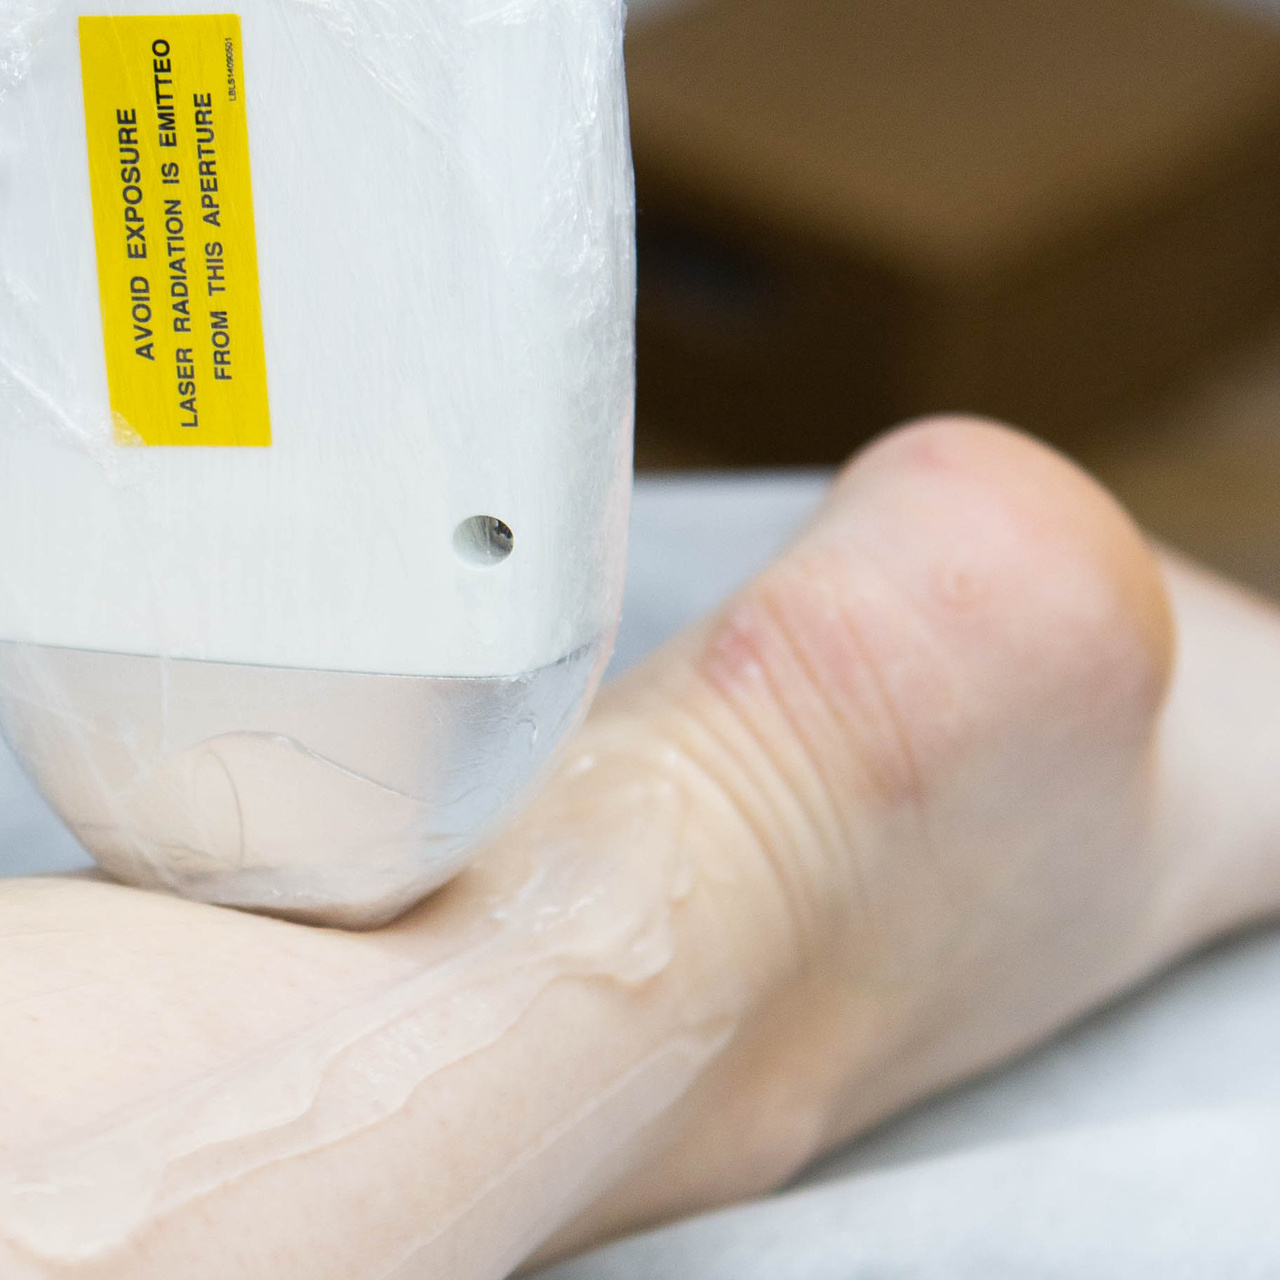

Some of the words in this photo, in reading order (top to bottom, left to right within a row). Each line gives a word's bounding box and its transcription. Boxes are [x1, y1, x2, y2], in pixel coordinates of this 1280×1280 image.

[116, 108, 147, 259] EXPOSURE
[160, 162, 180, 185] IS
[192, 92, 221, 228] APERTURE
[163, 199, 192, 333] RADIATION
[204, 241, 226, 297] THIS
[129, 275, 155, 361] AVOID
[209, 310, 233, 381] FROM
[175, 347, 199, 428] LASER
